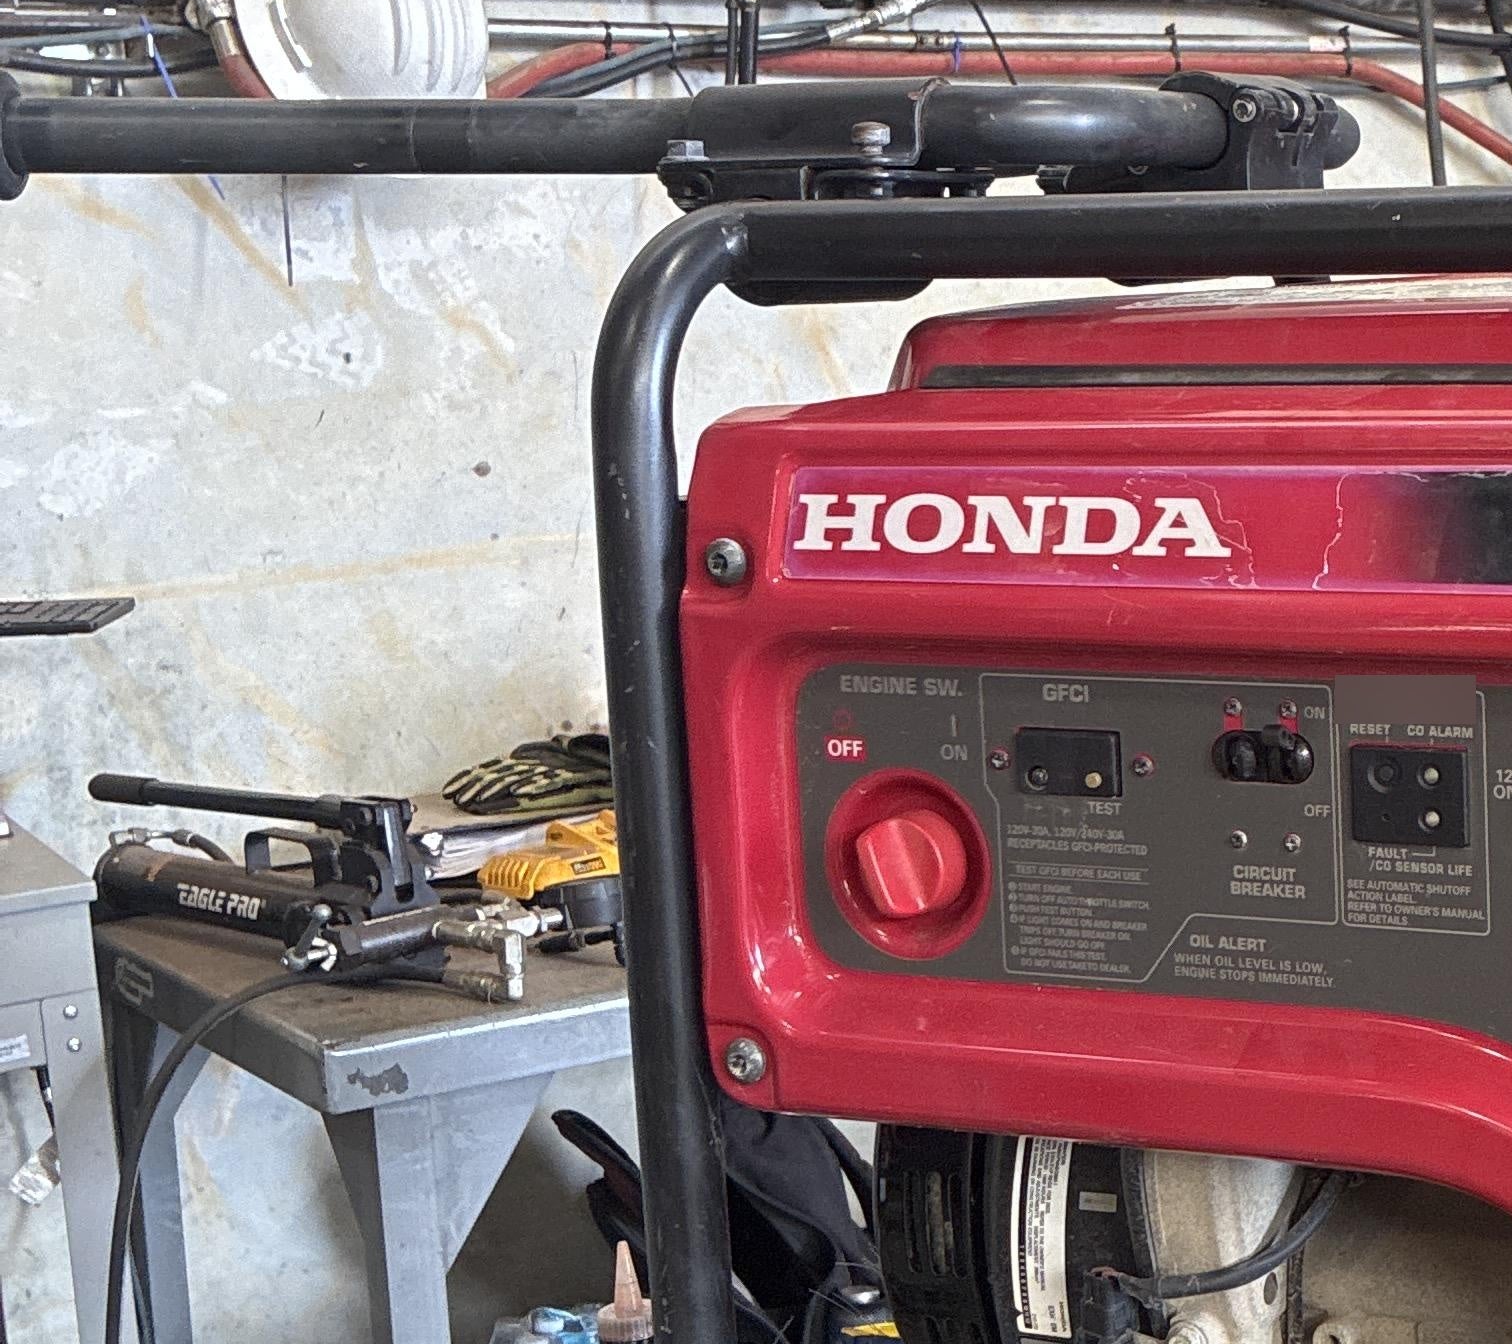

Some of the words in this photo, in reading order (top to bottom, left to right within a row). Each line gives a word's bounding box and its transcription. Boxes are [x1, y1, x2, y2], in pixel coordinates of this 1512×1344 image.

[794, 493, 1232, 557] HONDA
[840, 675, 917, 696] ENGINE
[923, 678, 963, 697] SW.
[1042, 683, 1089, 703] GFCI
[1304, 706, 1326, 720] ON
[1350, 723, 1391, 735] RESET
[1407, 725, 1427, 737] CO
[1429, 726, 1473, 739] ALARM
[827, 739, 863, 757] OFF
[940, 744, 968, 761] ON
[1087, 801, 1122, 816] TEST
[1304, 804, 1331, 818] OFF
[1007, 837, 1070, 852] RECEPTACLES
[1368, 846, 1408, 859] FAULT
[1016, 864, 1037, 875] TEST
[1039, 865, 1060, 876] GFCI
[1061, 866, 1095, 878] BEFORE
[1097, 868, 1121, 880] EACH
[1123, 870, 1143, 881] USE
[1233, 865, 1297, 882] CIRCUIT
[1395, 861, 1444, 875] SENSOR
[1447, 864, 1473, 877] LIFE
[1230, 881, 1306, 900] BREAKER
[1347, 879, 1365, 889] SEE
[1367, 880, 1424, 893] AUTOMATIC
[1426, 884, 1472, 896] SHUTOFF
[1347, 890, 1383, 902] ACTION
[177, 882, 226, 913] EAGLE
[226, 893, 260, 921] PRO
[1347, 901, 1377, 913] REFER
[1380, 903, 1393, 913] TO
[1394, 904, 1440, 917] OWNER'S
[1441, 907, 1486, 920] MANUAL
[1348, 912, 1367, 923] FOR
[1189, 934, 1214, 948] OIL
[1218, 936, 1267, 952] ALERT
[1173, 953, 1211, 966] WHEN
[1214, 955, 1234, 967] OIL
[1238, 957, 1275, 971] LEVEL
[1279, 959, 1291, 971] IS
[1174, 965, 1216, 979] ENGINE
[1219, 968, 1255, 982] STOPS
[1258, 971, 1337, 988] IMMEDIATELY.
